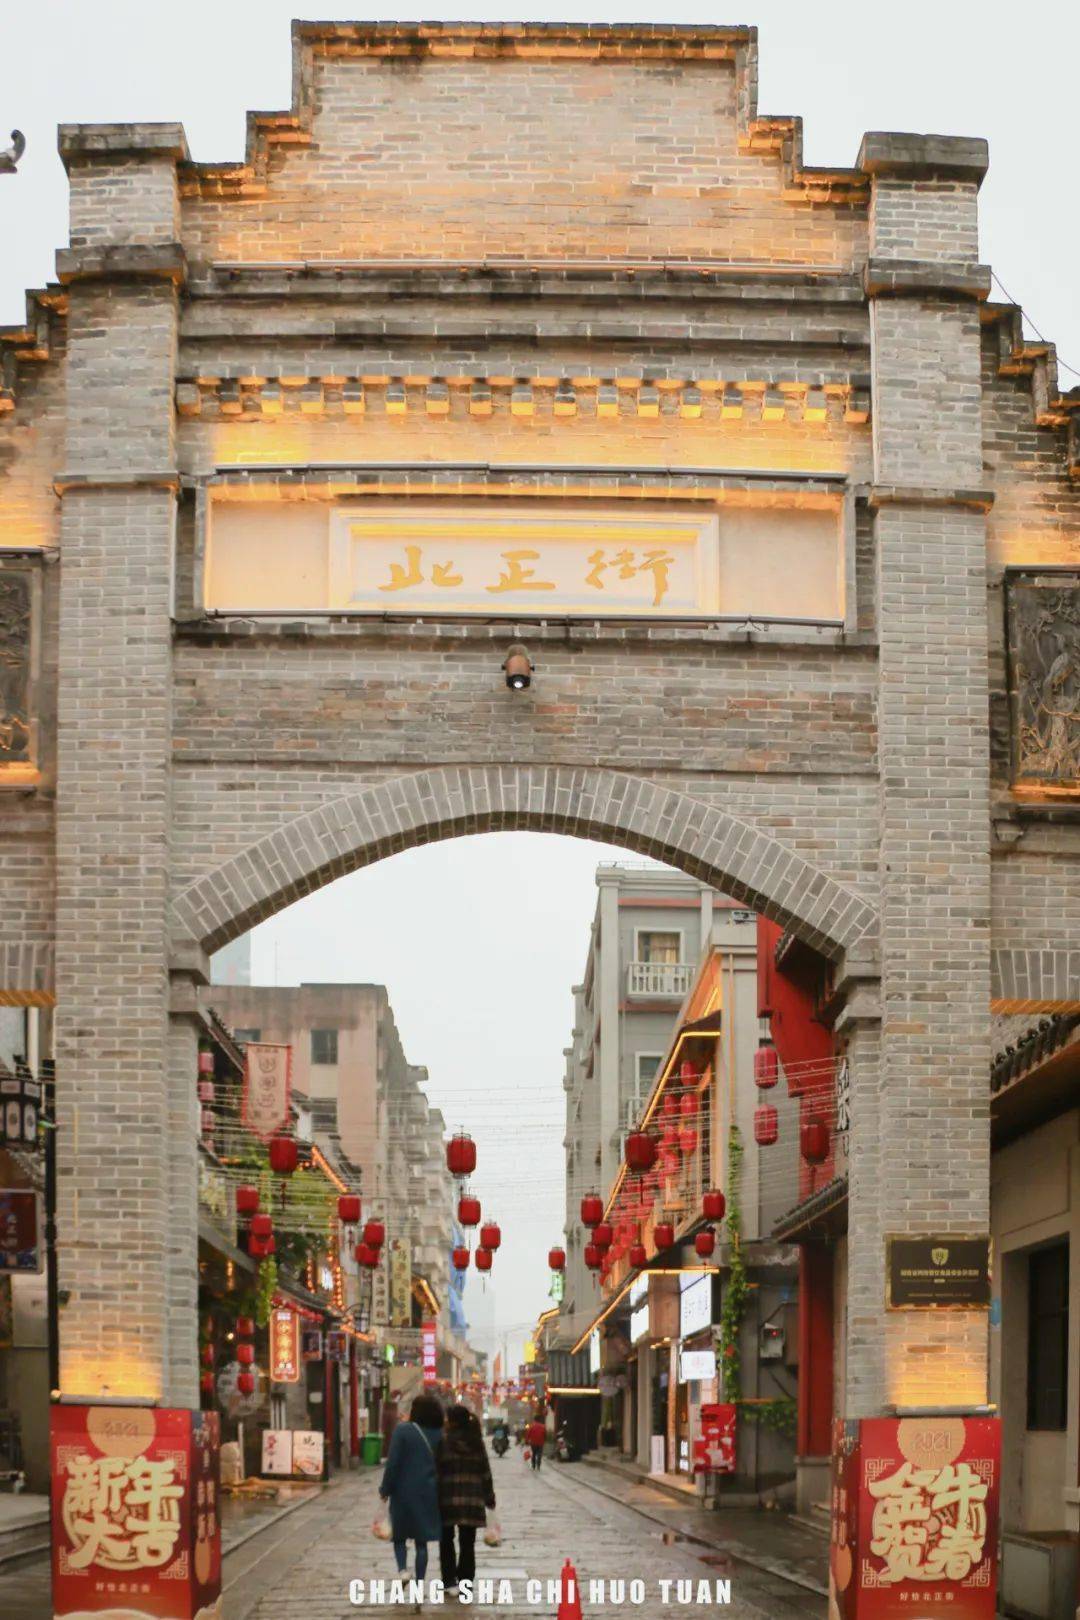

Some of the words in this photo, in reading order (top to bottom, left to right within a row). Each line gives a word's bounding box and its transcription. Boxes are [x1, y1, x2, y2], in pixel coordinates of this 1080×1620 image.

[378, 545, 676, 607] 北正街
[66, 1455, 185, 1514] 新年
[868, 1461, 989, 1530] 金牛
[67, 1512, 182, 1569] 大吉
